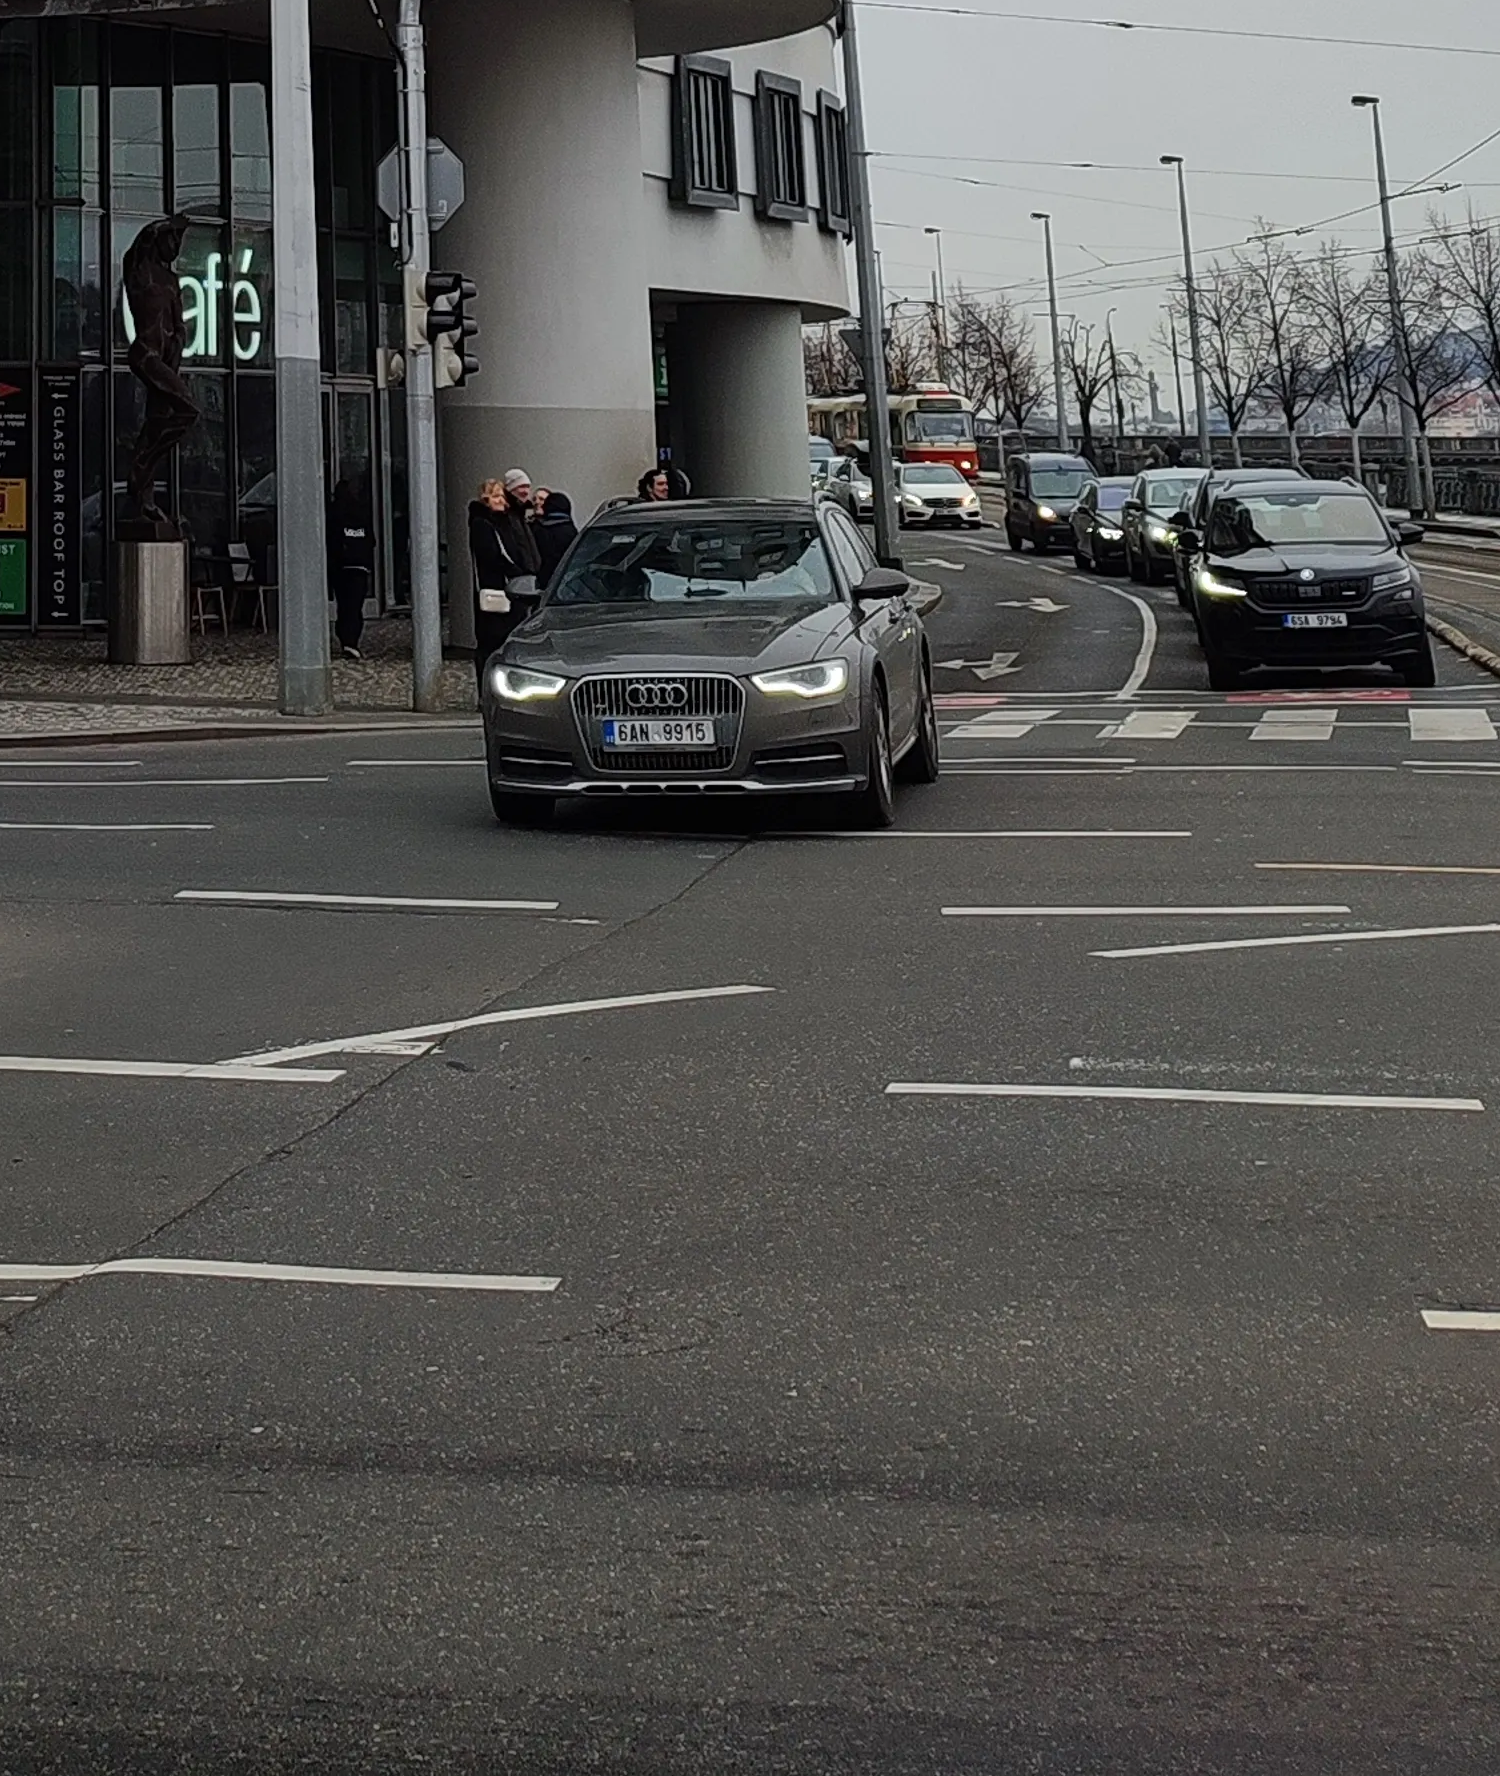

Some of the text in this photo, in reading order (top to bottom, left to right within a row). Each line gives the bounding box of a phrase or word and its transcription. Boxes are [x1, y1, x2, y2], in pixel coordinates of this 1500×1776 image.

[122, 248, 262, 361] afé
[53, 406, 66, 606] GLASS BAR ROOF TOP
[618, 723, 650, 743] 6AN
